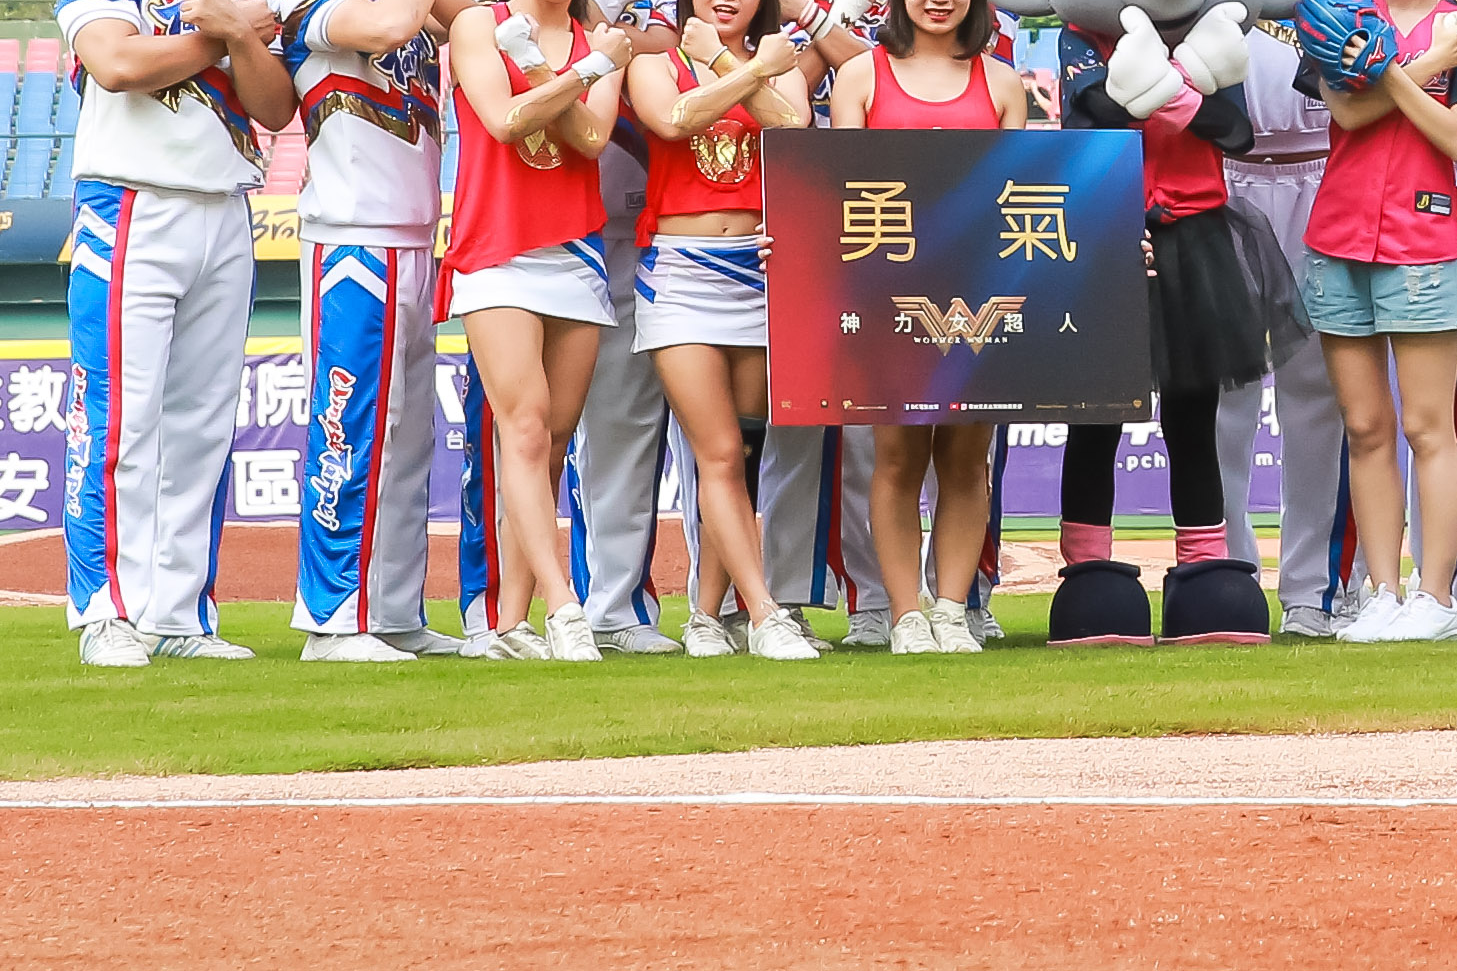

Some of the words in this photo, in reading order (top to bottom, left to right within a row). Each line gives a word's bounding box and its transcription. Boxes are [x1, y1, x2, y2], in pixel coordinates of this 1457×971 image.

[839, 179, 1078, 263] 勇氣
[840, 311, 1079, 335] 神力女超人
[0, 364, 67, 433] 教
[231, 449, 302, 516] 區
